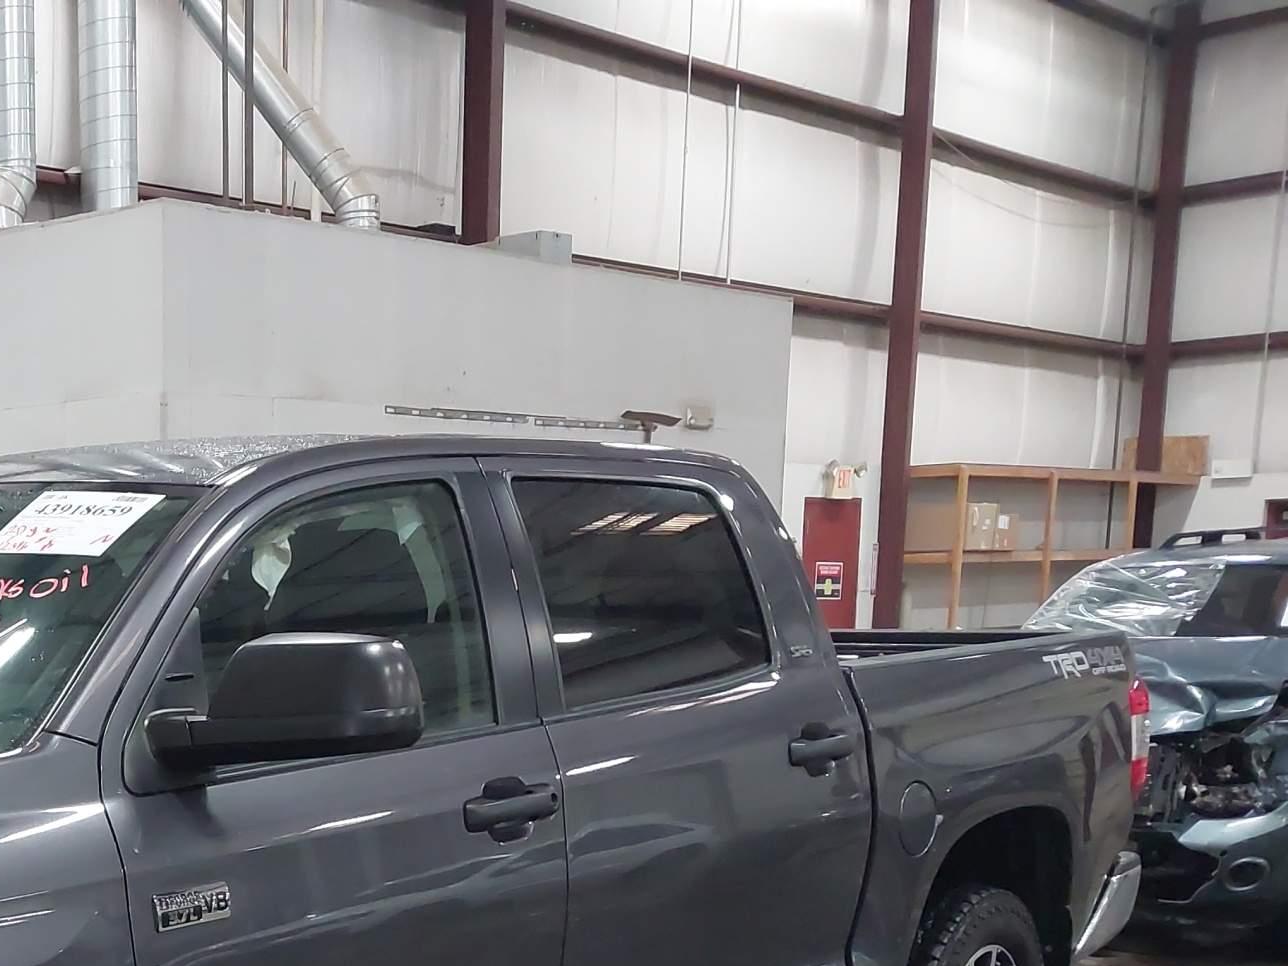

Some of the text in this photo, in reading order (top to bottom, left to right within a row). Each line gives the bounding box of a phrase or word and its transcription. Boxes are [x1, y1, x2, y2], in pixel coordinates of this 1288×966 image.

[34, 502, 133, 518] 43918659
[1042, 650, 1090, 680] TRD
[202, 890, 229, 914] V8
